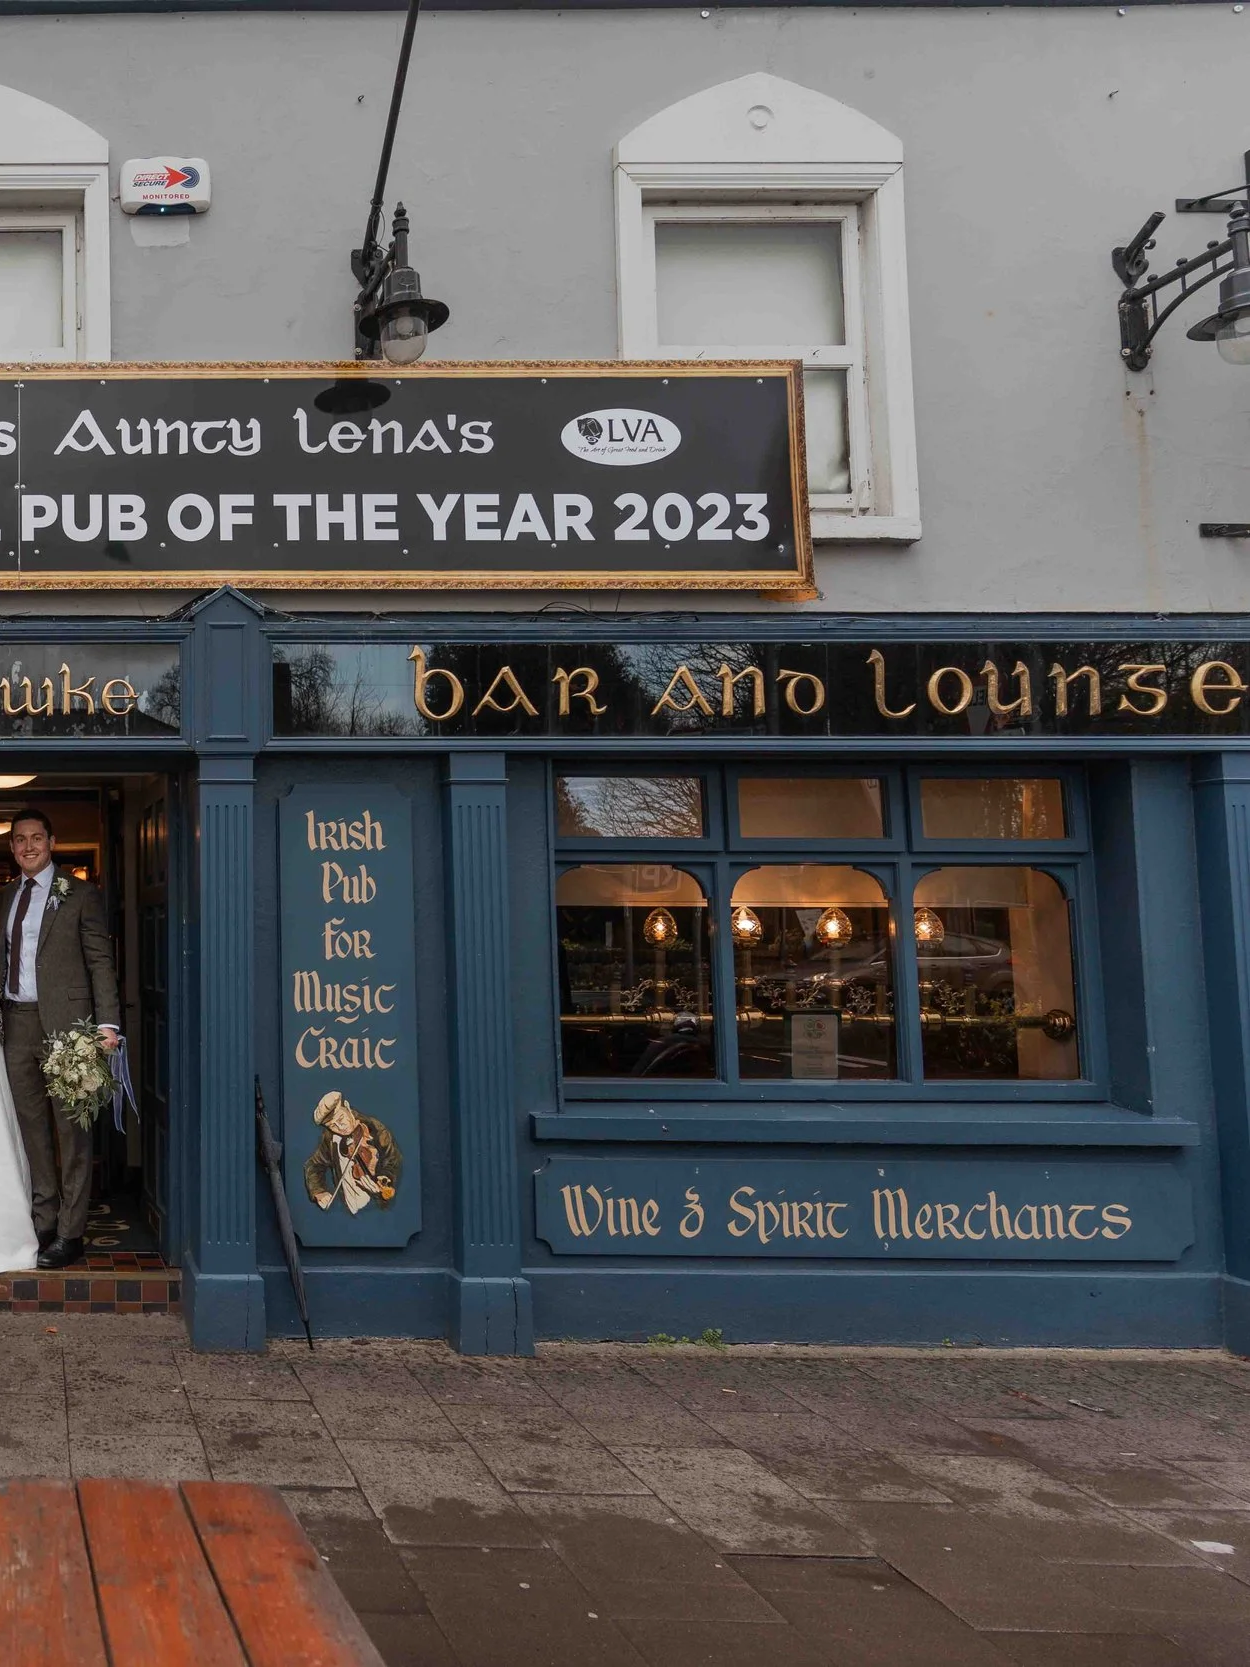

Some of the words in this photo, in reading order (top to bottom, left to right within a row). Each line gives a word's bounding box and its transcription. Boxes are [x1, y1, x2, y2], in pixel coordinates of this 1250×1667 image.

[54, 410, 260, 457] Aunty
[607, 418, 664, 442] LVA
[21, 494, 148, 542] PUB
[167, 494, 255, 542] OF
[273, 494, 400, 541] THE
[416, 493, 596, 541] YEAR
[614, 493, 770, 542] 2023
[304, 809, 386, 851] Irish
[321, 861, 377, 904] Pub
[293, 970, 397, 1014] Music
[295, 1026, 397, 1069] Craic
[560, 1184, 661, 1237] Wine
[727, 1186, 849, 1244] Spirit
[871, 1188, 1133, 1240] Merchants
